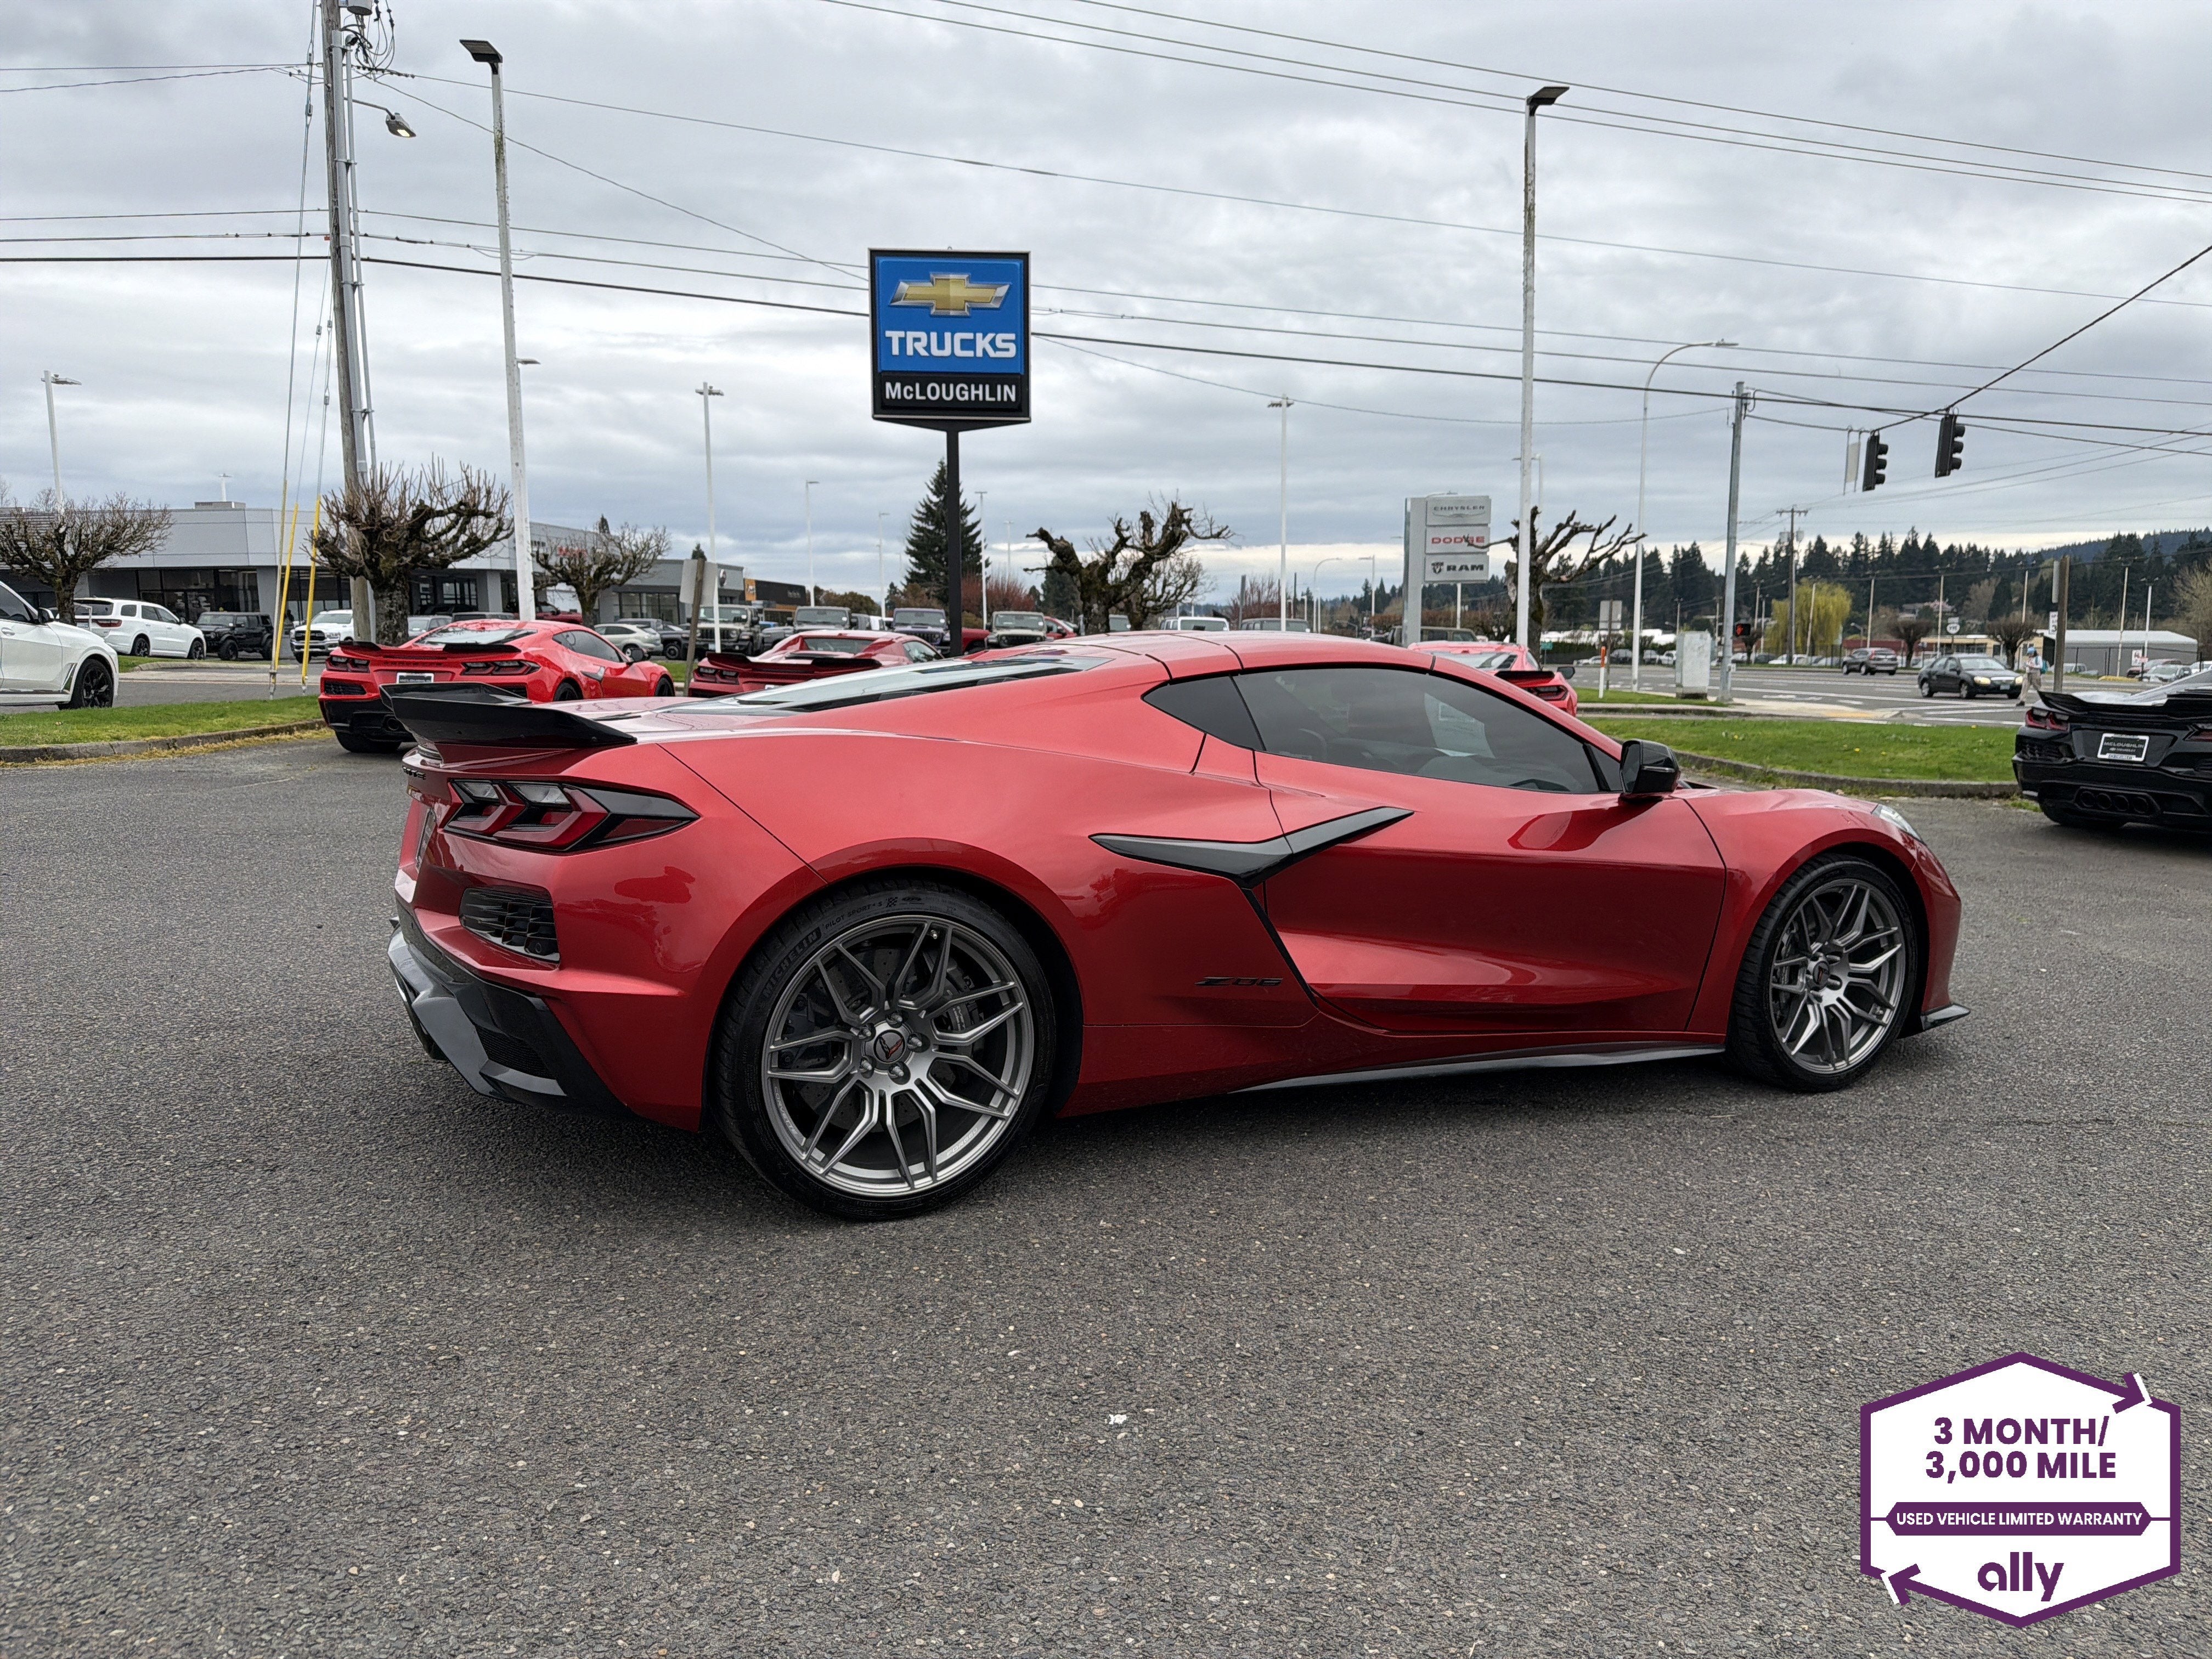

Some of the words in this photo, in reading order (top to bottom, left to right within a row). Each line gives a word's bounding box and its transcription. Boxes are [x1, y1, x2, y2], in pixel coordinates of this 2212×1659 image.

[885, 330, 1016, 358] TRUCKS
[885, 382, 1016, 402] McLOUGHLIN
[825, 915, 845, 930] PILOT
[847, 904, 871, 917] SPORT
[763, 931, 818, 998] MICHELIN
